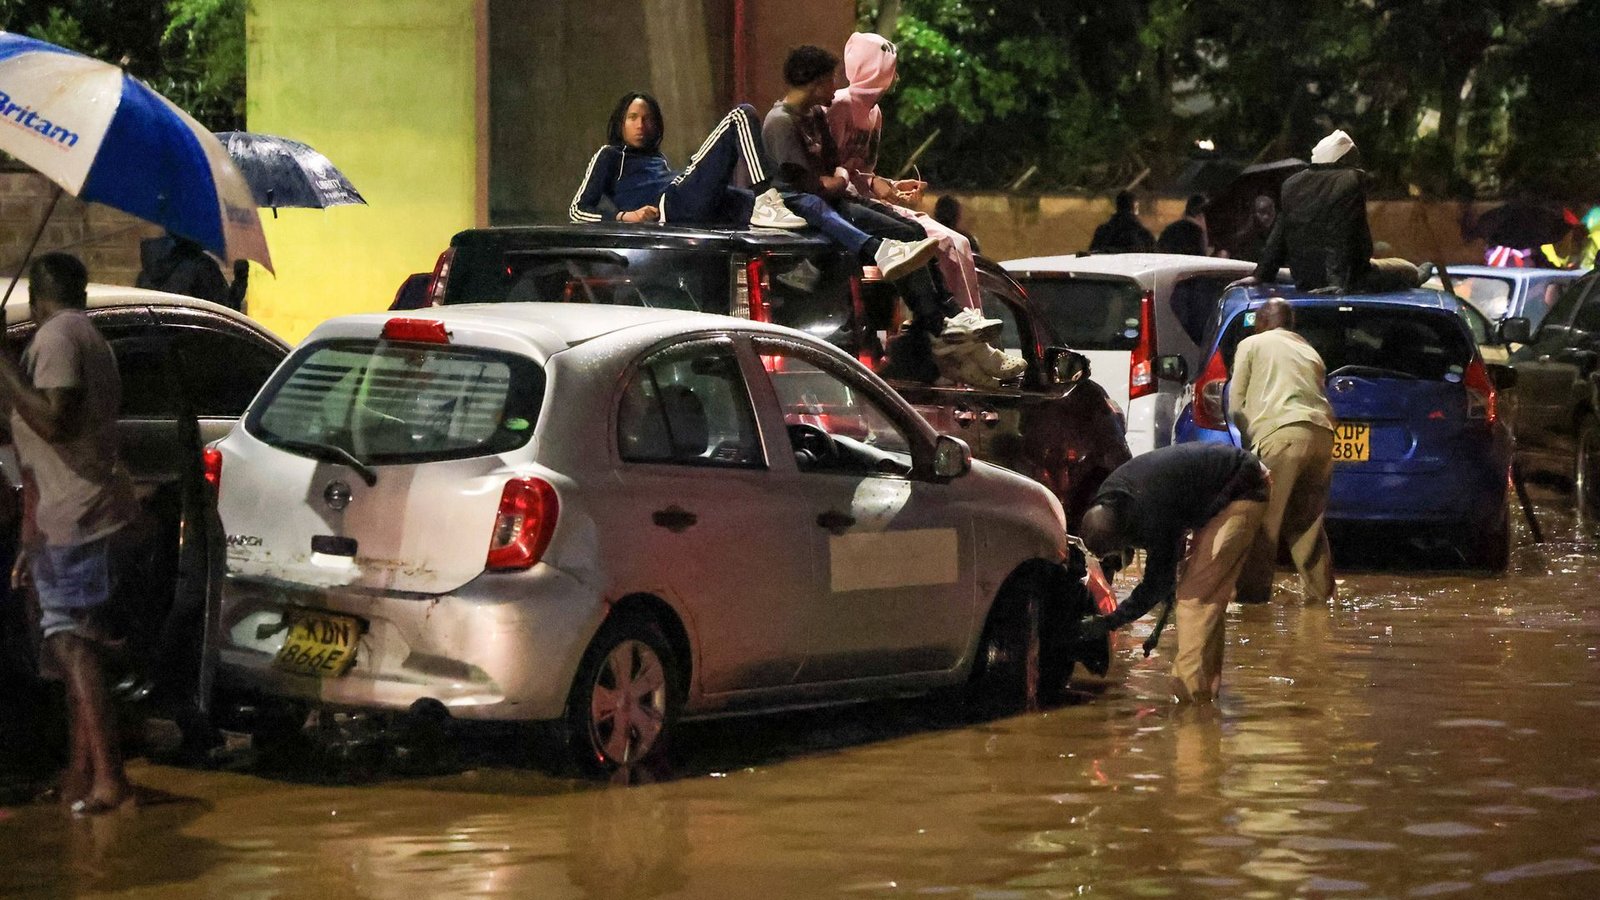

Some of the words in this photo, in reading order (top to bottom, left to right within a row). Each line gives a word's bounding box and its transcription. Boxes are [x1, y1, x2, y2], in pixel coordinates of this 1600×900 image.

[0, 90, 79, 147] Britam
[1333, 442, 1364, 459] 38Y
[305, 619, 349, 647] KDN
[282, 644, 344, 670] 866E
